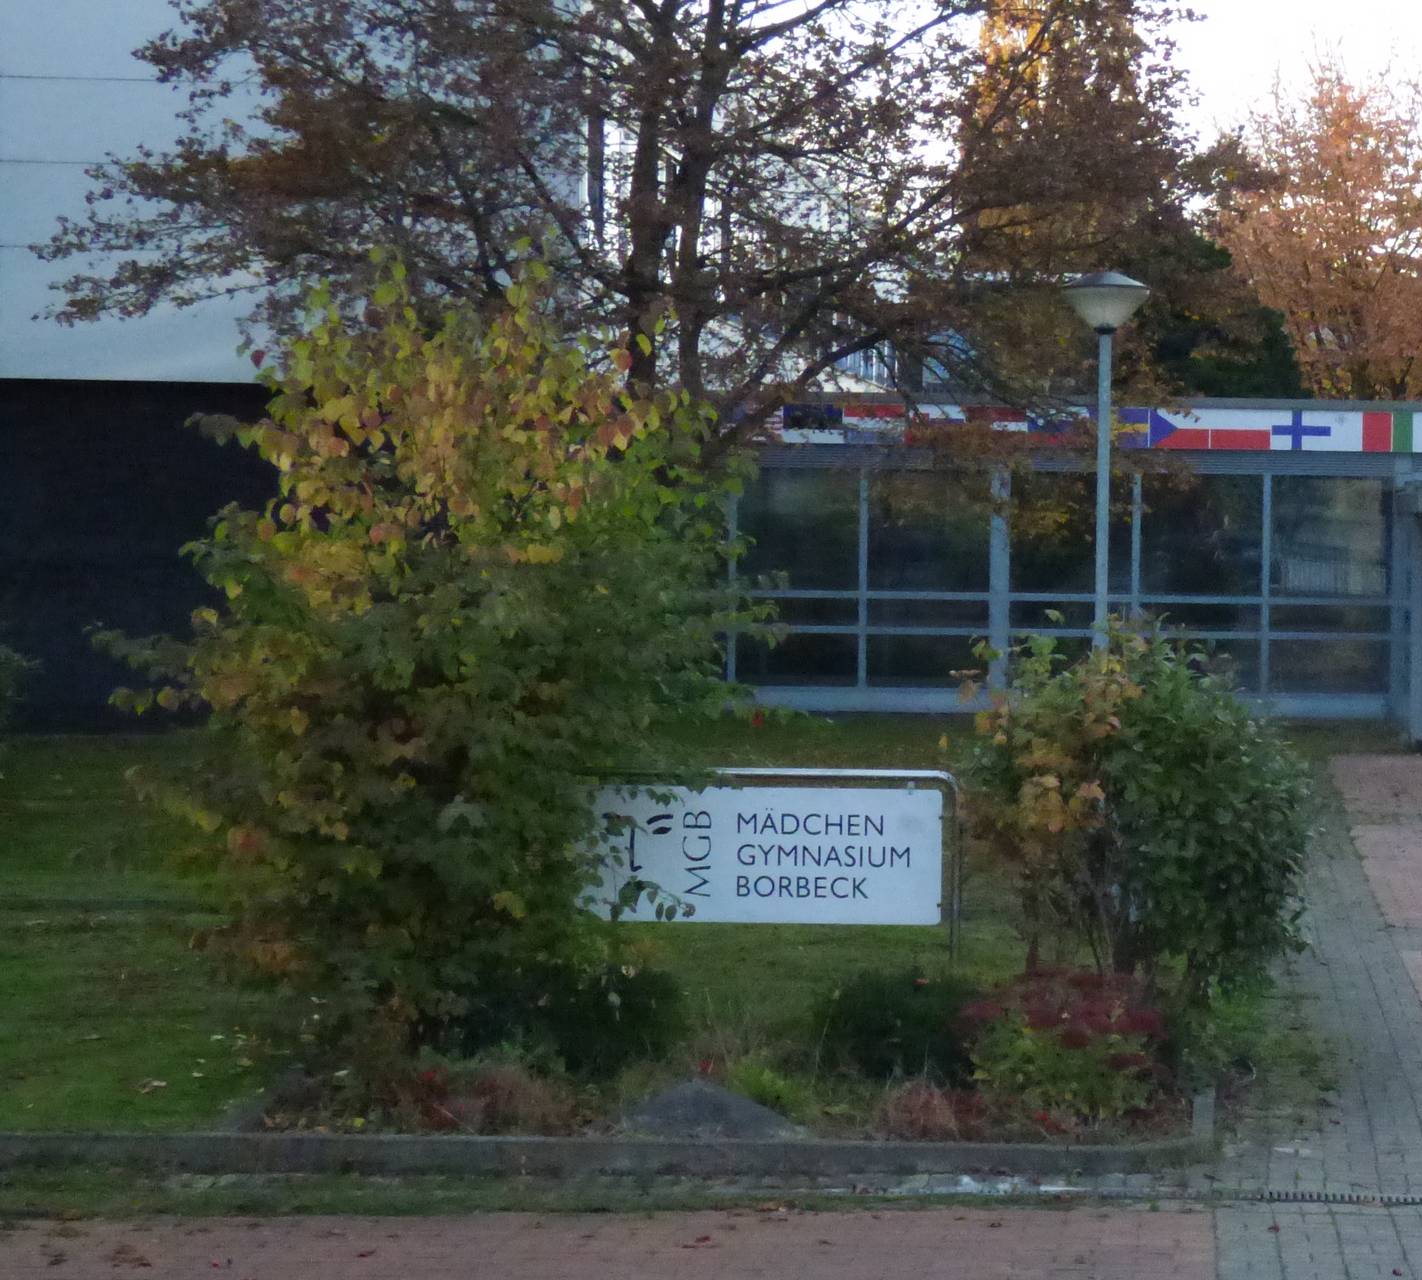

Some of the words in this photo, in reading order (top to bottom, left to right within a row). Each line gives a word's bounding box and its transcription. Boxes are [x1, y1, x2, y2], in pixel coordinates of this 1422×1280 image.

[737, 808, 884, 836] MÄDCHEN
[683, 810, 712, 897] MGB
[737, 844, 911, 868] GYMNASIUM
[736, 875, 869, 899] BORBECK
